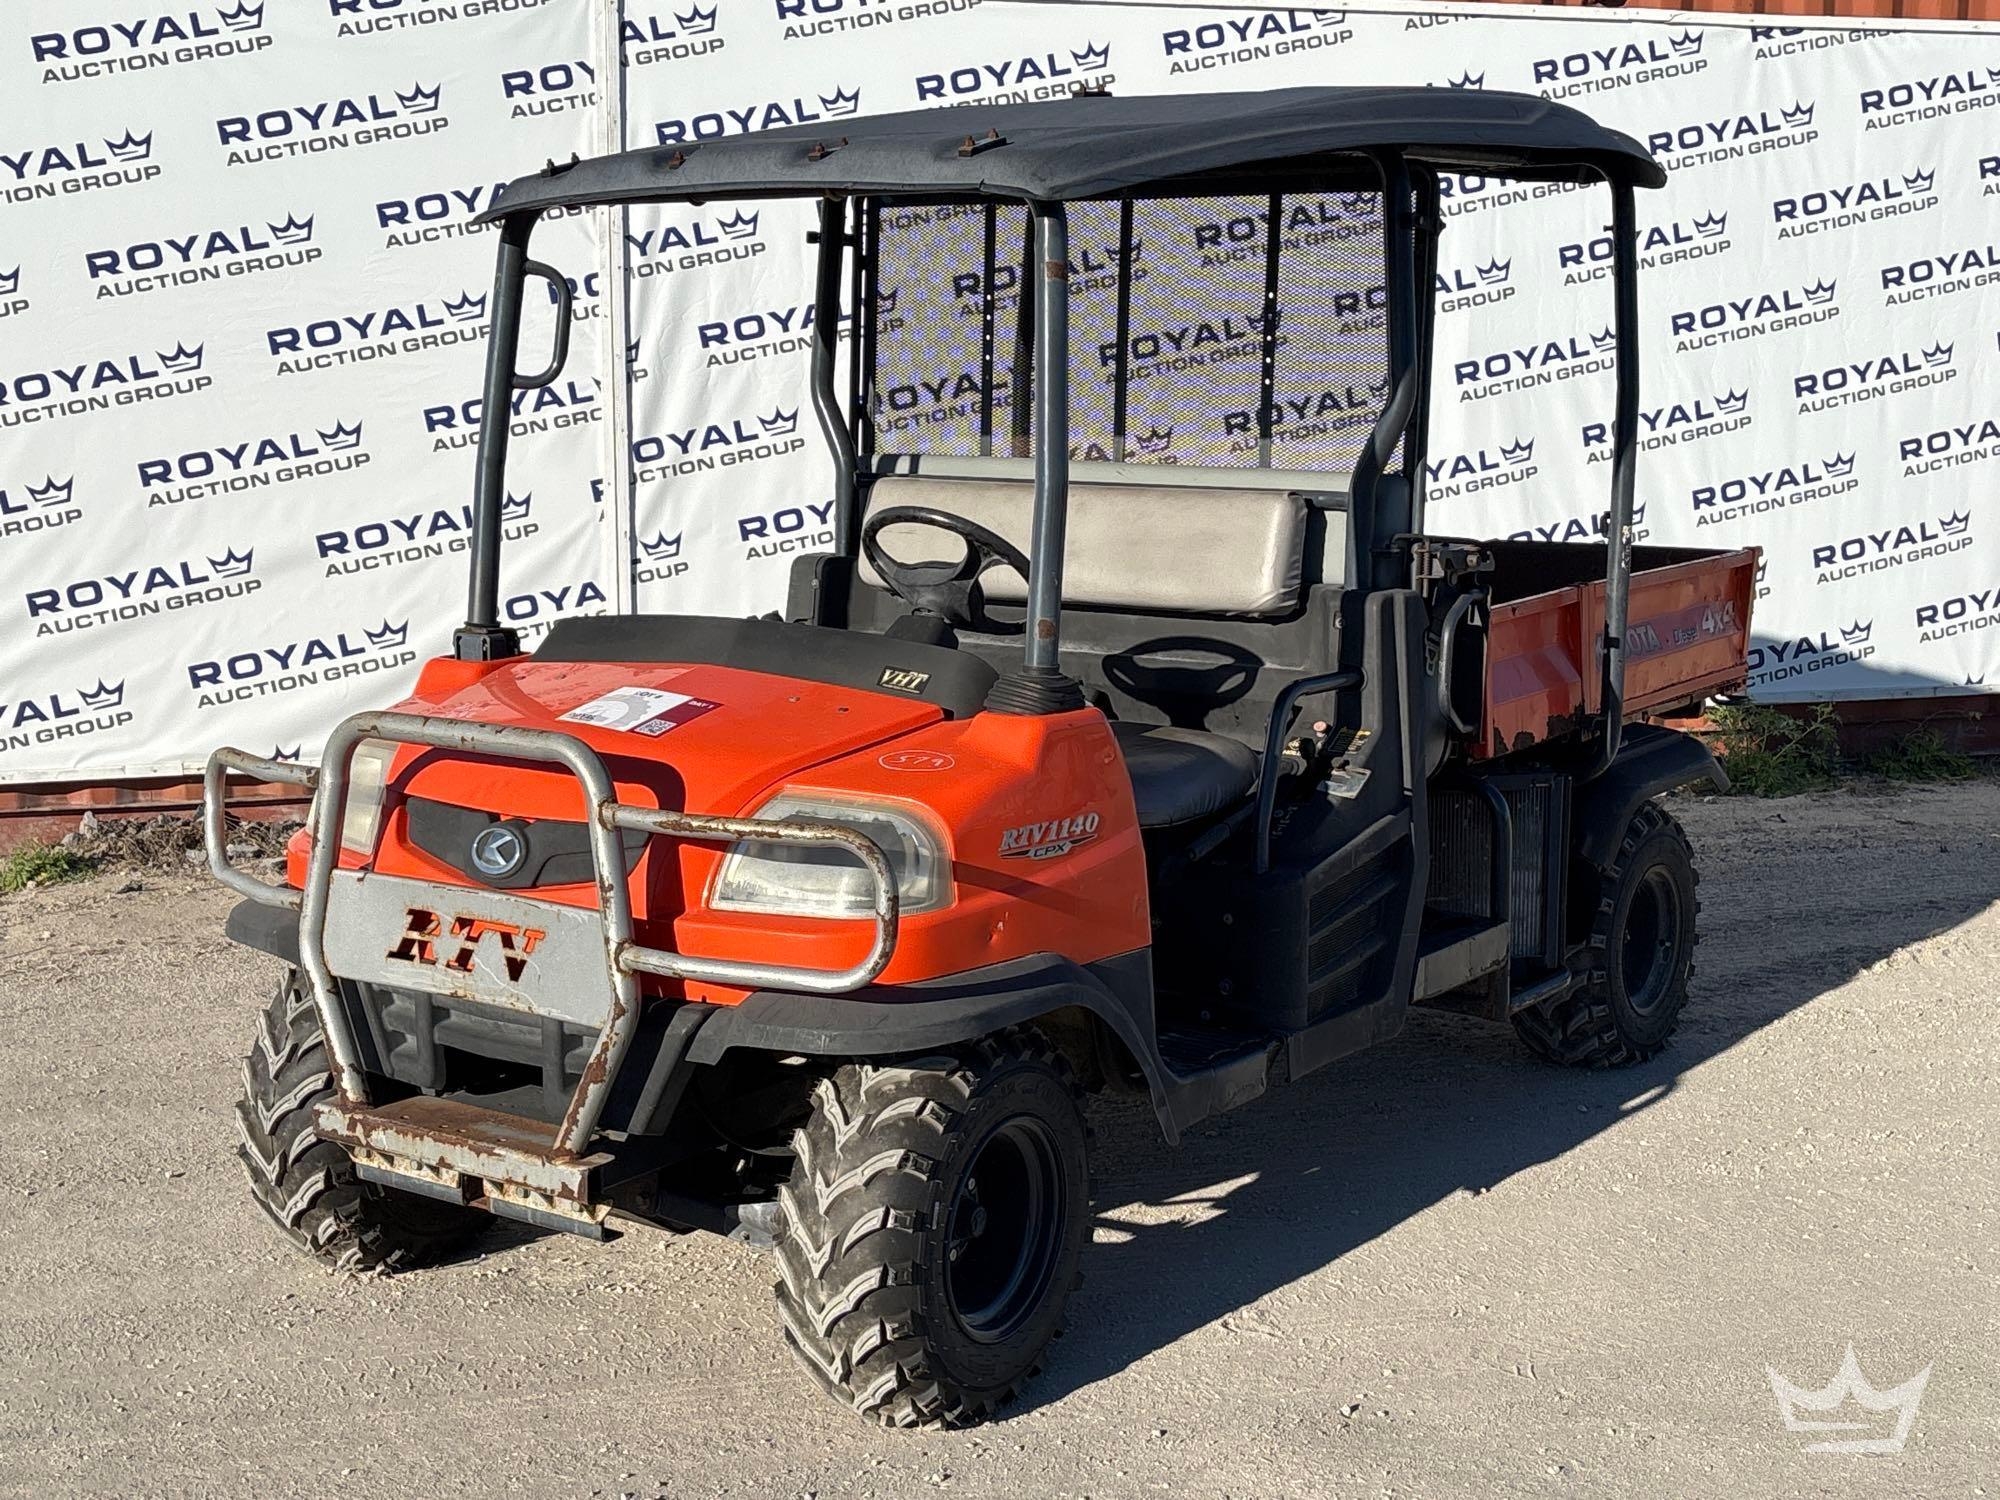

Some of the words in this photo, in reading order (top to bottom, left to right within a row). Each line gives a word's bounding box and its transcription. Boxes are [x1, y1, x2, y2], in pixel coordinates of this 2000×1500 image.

[31, 12, 219, 62] ROYAL
[338, 6, 457, 37] AUCTION
[784, 10, 892, 40] AUCTION
[1163, 10, 1312, 56] ROYAL
[43, 52, 169, 84] AUCTION
[175, 36, 272, 62] GROUP
[636, 38, 724, 65] GROUP
[1170, 45, 1270, 75] AUCTION
[1275, 30, 1353, 55] GROUP
[1533, 40, 1669, 84] ROYAL
[1755, 33, 1846, 60] AUCTION
[502, 61, 595, 98] ROY
[916, 54, 1072, 101] ROYAL
[1539, 74, 1631, 102] AUCTION
[1636, 60, 1707, 83] GROUP
[1861, 71, 1987, 113] ROYAL
[217, 95, 397, 145] ROYAL
[655, 99, 820, 146] ROYAL
[1648, 112, 1781, 156] ROYAL
[1866, 103, 1951, 131] AUCTION
[1955, 93, 2000, 113] GRO
[0, 143, 107, 179] YAL
[227, 134, 348, 166] AUCTION
[355, 118, 448, 144] GROUP
[1748, 131, 1818, 154] GROUP
[62, 165, 161, 193] GROUP
[1774, 179, 1902, 222] ROYAL
[627, 223, 719, 257] YAL
[1778, 211, 1866, 240] AUCTION
[1871, 197, 1938, 220] GROUP
[86, 227, 270, 278] ROYAL
[679, 243, 765, 269] GROUP
[1560, 222, 1693, 268] ROAL
[1564, 256, 1655, 286] AUCTN
[1660, 240, 1730, 265] GROUP
[97, 265, 220, 299] AUCTION
[226, 248, 322, 276] GROUP
[1881, 246, 2000, 289] ROYAL
[1442, 287, 1515, 312] GROUP
[1672, 290, 1802, 336] ROYAL
[1886, 278, 1970, 306] AUCTION
[267, 304, 444, 355] ROYAL
[707, 335, 815, 368] AUCTION
[1676, 323, 1765, 353] AUCTION
[1770, 307, 1839, 331] GROUP
[277, 342, 396, 375] AUCTION
[1455, 337, 1590, 384] ROYAL
[1460, 371, 1551, 402] AUCTION
[1557, 355, 1616, 380] GROU
[1794, 353, 1921, 398] ROYAL
[0, 356, 159, 406] OYAL
[1, 395, 110, 427] UCTION
[115, 376, 212, 405] GROUP
[1799, 385, 1885, 415] AUCTION
[1890, 369, 1956, 393] GROUP
[433, 419, 547, 452] AUCON
[554, 408, 602, 429] GRO
[633, 420, 759, 463] OYAL
[1582, 400, 1714, 447] RYAL
[1587, 434, 1676, 464] AUION
[1682, 416, 1751, 441] GROUP
[1900, 421, 2000, 461] ROYA
[138, 434, 319, 487] ROYAL
[149, 472, 270, 507] AUCTION
[276, 453, 370, 482] GROUP
[633, 456, 714, 485] CTION
[720, 438, 805, 466] GROUP
[1425, 451, 1499, 483] YAL
[1466, 466, 1537, 492] GROUP
[1904, 448, 1987, 477] AUCTION
[1692, 464, 1822, 510] ROYAL
[1697, 496, 1785, 527] AUCTION
[1790, 479, 1858, 504] GROUP
[0, 509, 83, 537] ROUP
[738, 500, 835, 541] ROY
[326, 543, 443, 577] AUCTION
[746, 531, 835, 560] AUCTIO
[1813, 522, 1938, 568] ROYAL
[1817, 554, 1902, 584] AUCTION
[1908, 537, 1972, 562] GROUP
[26, 562, 209, 617] ROYAL
[634, 562, 688, 584] OUP
[37, 600, 160, 637] AUCTION
[166, 580, 261, 609] GROUP
[505, 582, 606, 620] OYA
[1916, 588, 2000, 628] ROY
[188, 634, 366, 689] ROYAL
[1746, 633, 1839, 671] OYAL
[1746, 662, 1804, 688] CTION
[1807, 646, 1875, 673] GROUP
[198, 672, 317, 708] AUCTION
[324, 651, 416, 681] GROUP
[36, 712, 132, 743] GROUP
[1000, 813, 1099, 850] RTV1140
[1033, 842, 1067, 857] CPX
[386, 908, 546, 983] RTV
